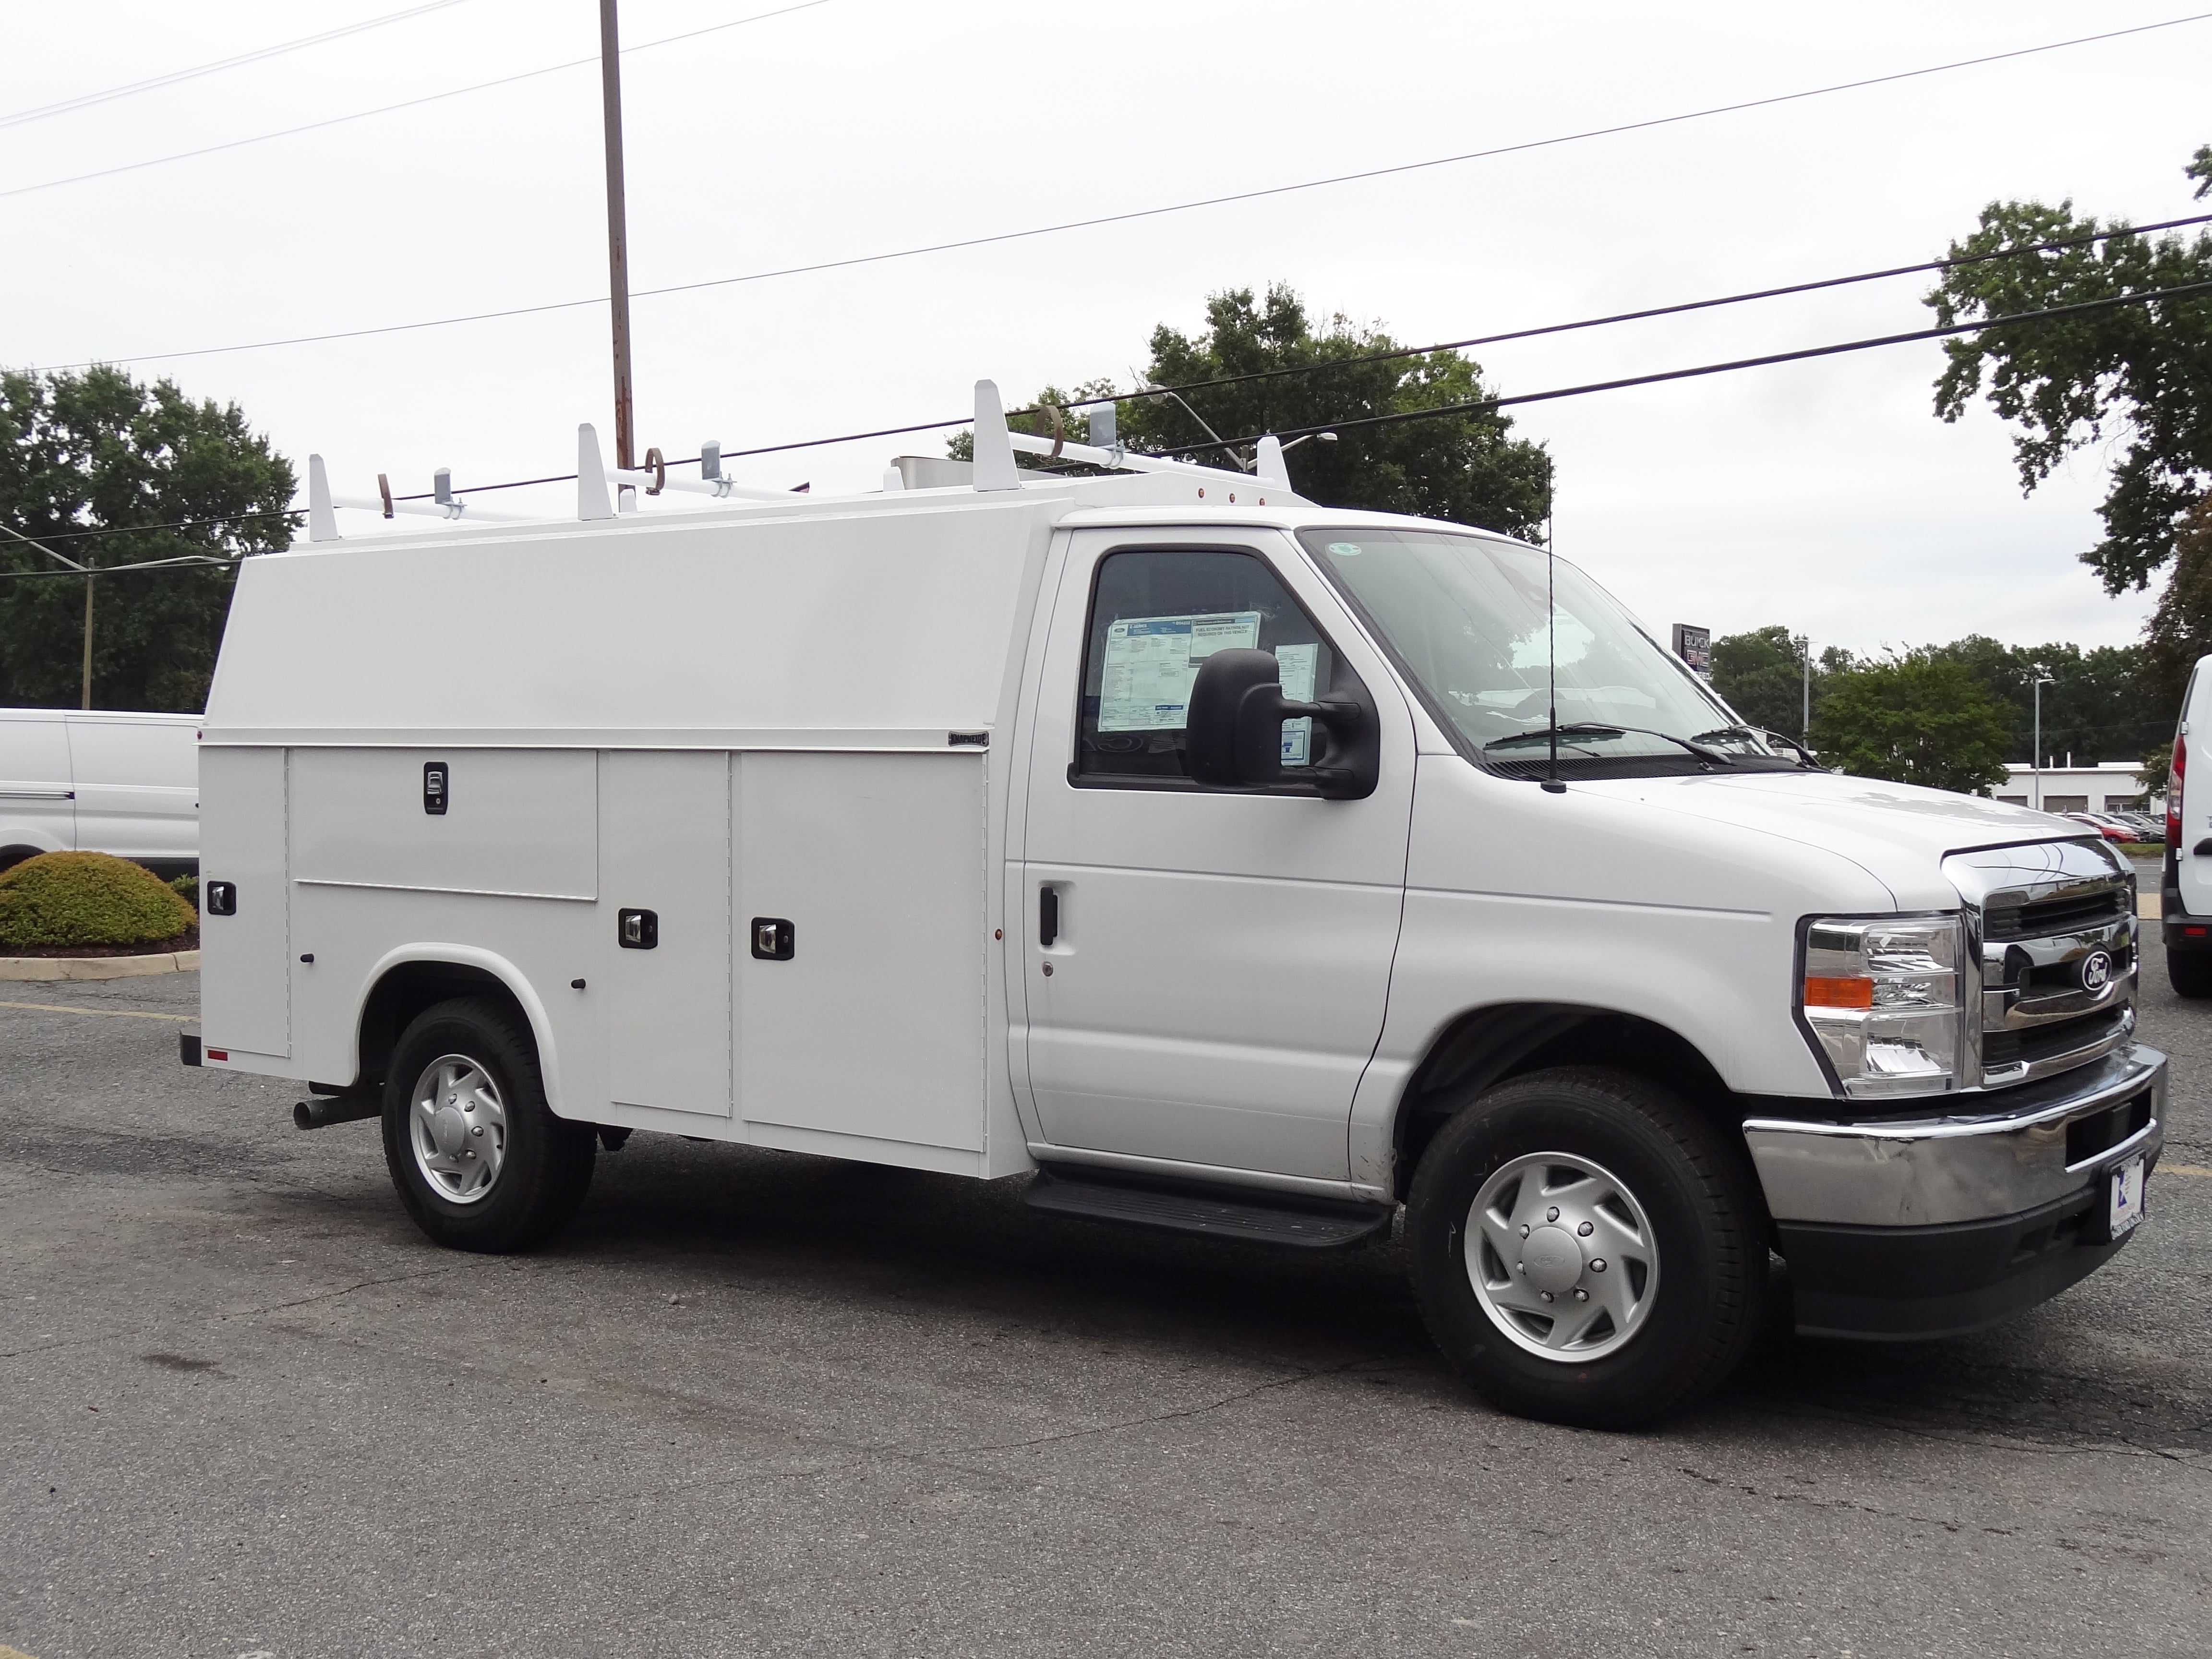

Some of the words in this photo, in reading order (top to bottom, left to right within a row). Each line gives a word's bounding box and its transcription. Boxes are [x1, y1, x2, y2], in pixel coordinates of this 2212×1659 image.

[1684, 635, 1710, 649] BUICK
[1686, 649, 1709, 667] GMC
[2088, 957, 2108, 985] Ford
